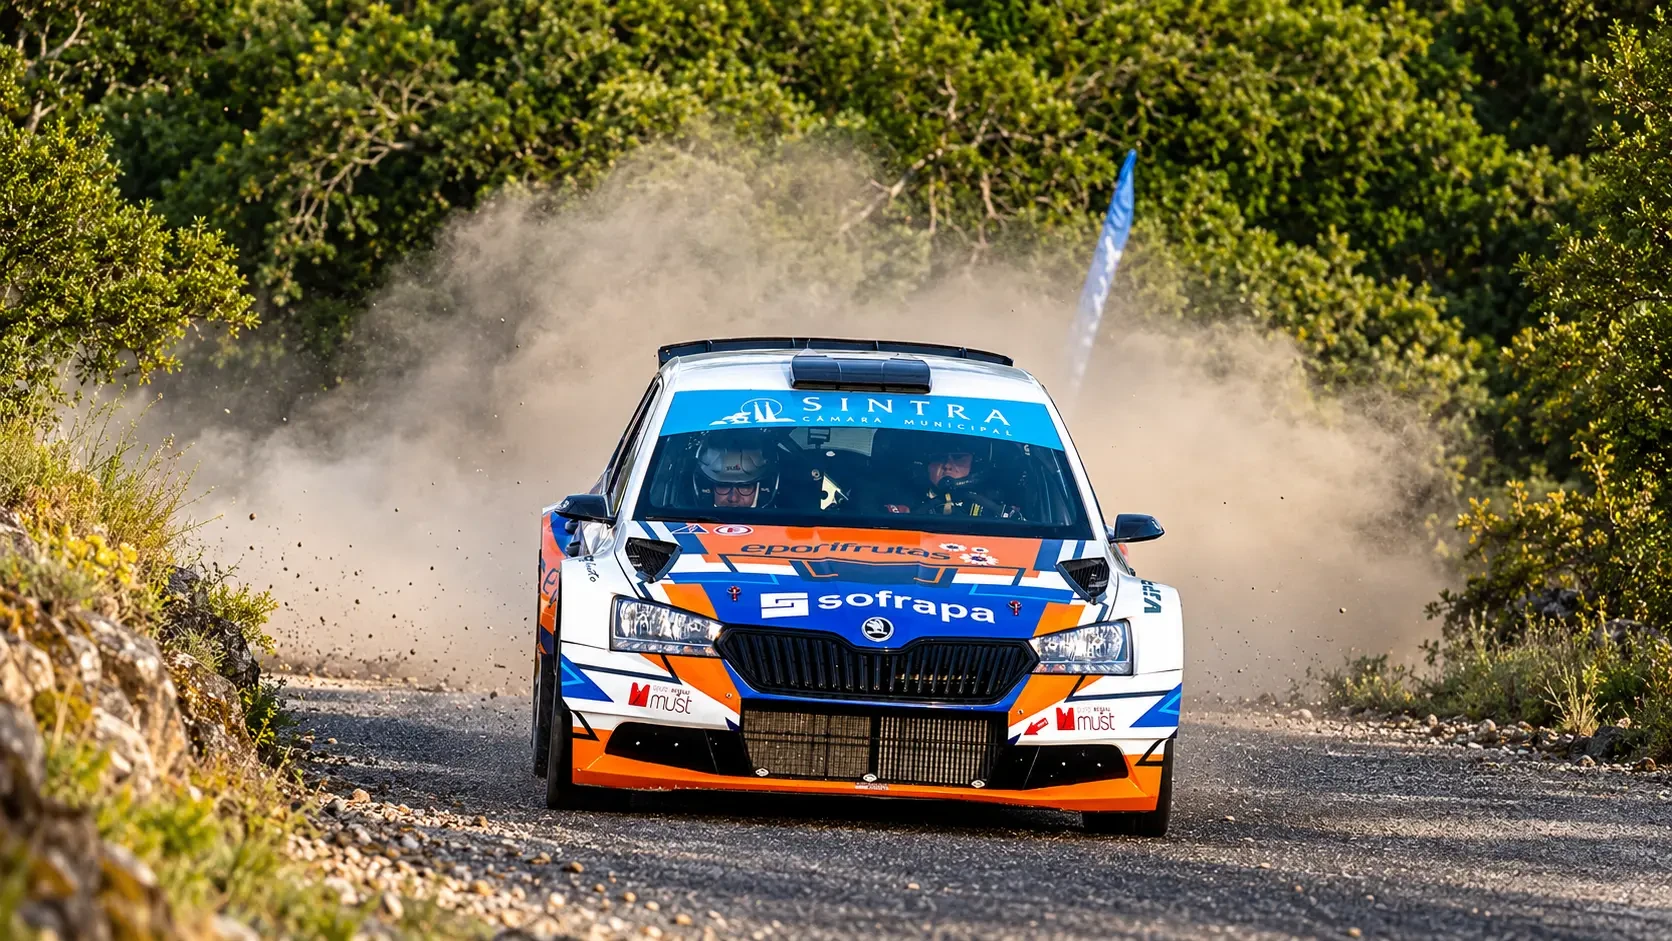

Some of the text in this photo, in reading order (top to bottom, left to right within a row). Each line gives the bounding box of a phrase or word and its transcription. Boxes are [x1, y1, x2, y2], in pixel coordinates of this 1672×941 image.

[803, 396, 1011, 427] SINTRA
[802, 415, 1013, 437] CÂMARA MUNICIPAL
[740, 542, 952, 561] eporifrutas
[817, 590, 996, 624] sofrapa
[649, 694, 692, 715] must
[1077, 712, 1116, 731] must
